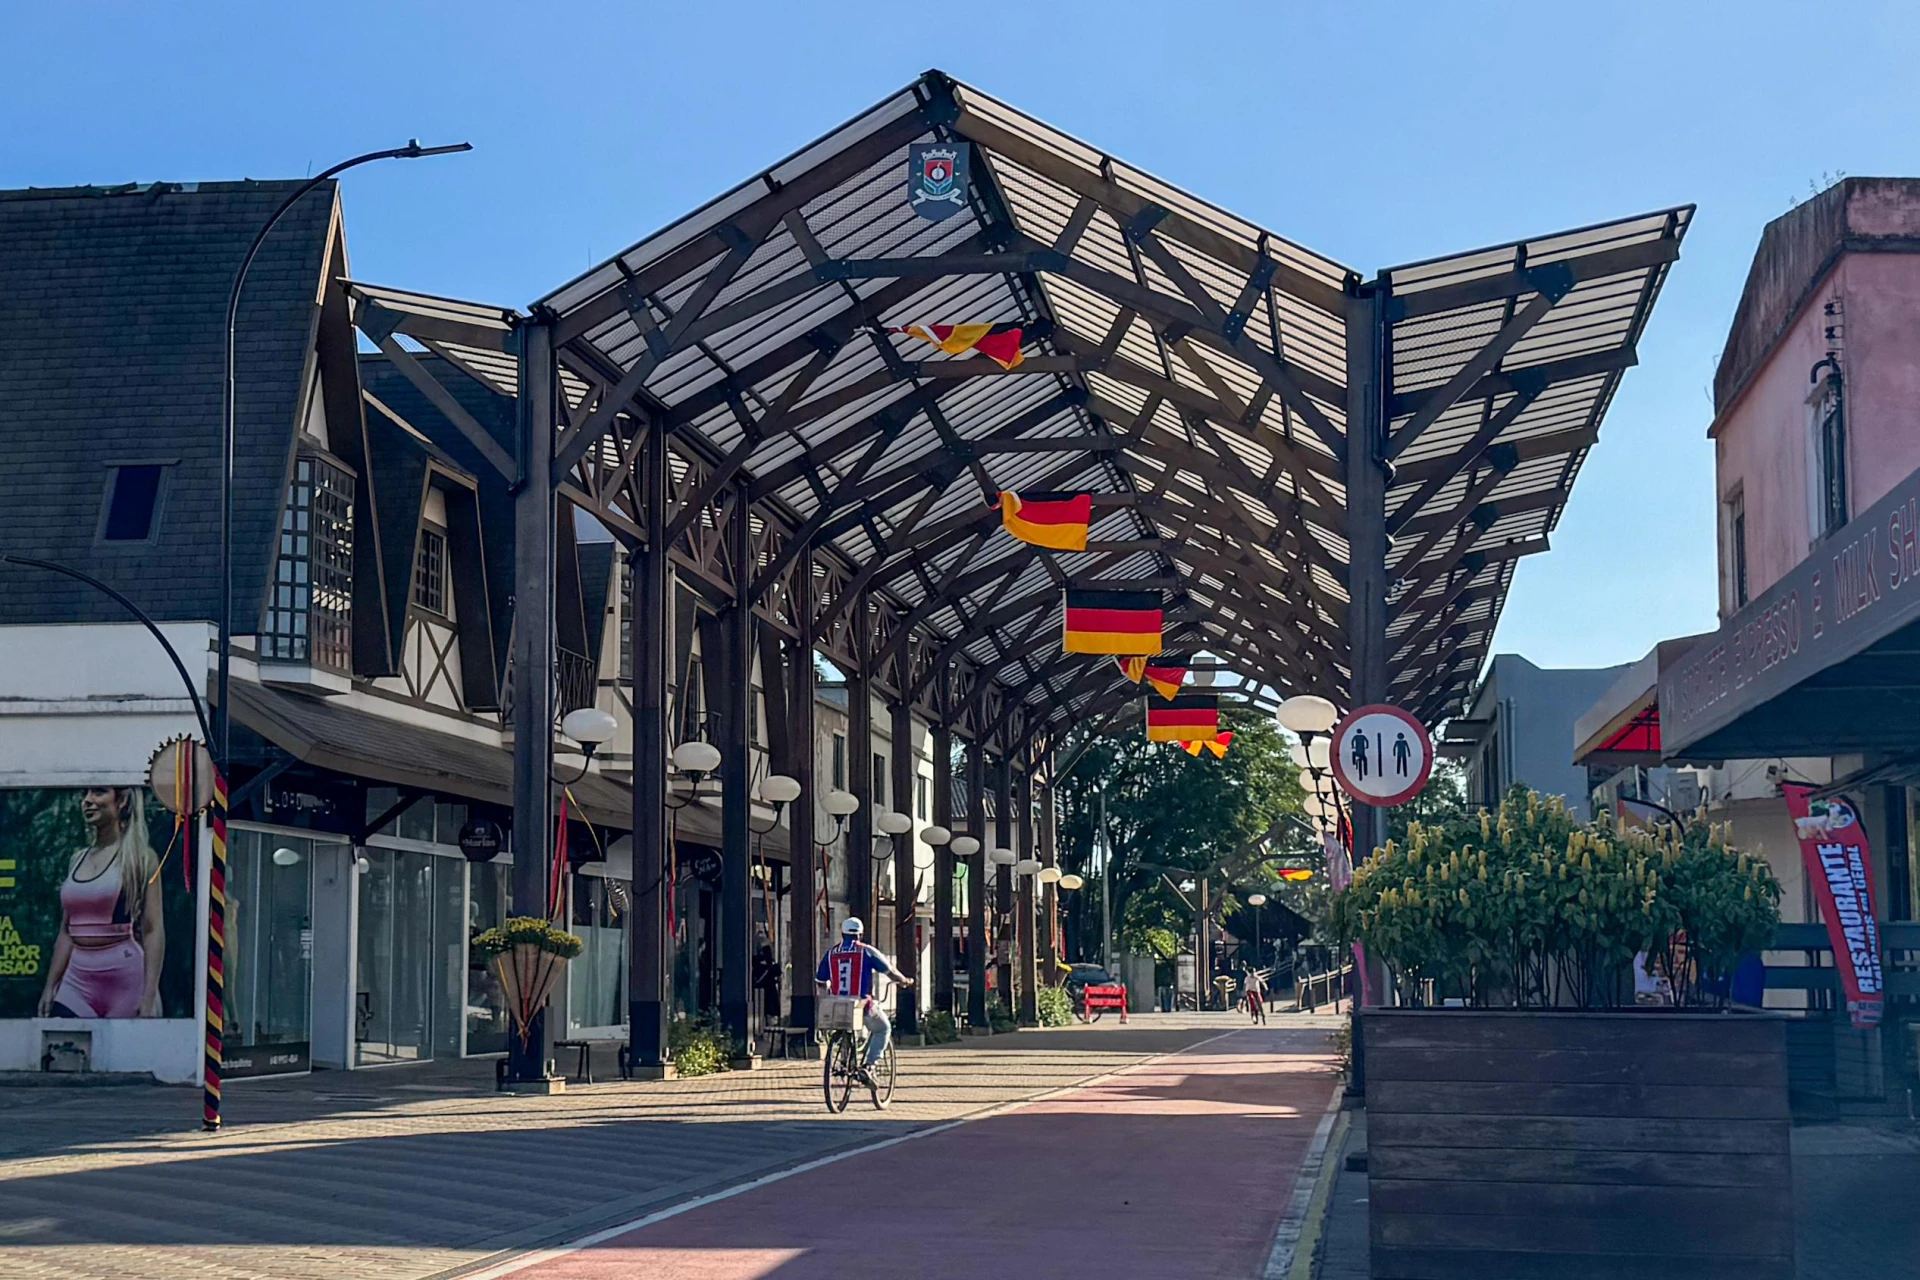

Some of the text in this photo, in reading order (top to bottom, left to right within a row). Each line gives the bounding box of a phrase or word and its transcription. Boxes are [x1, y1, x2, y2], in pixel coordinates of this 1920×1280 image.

[1812, 570, 1823, 640] E
[1833, 526, 1881, 624] MILK
[1888, 497, 1920, 591] SH
[1816, 843, 1877, 993] RESTAURANTE
[1846, 845, 1867, 889] GERAL
